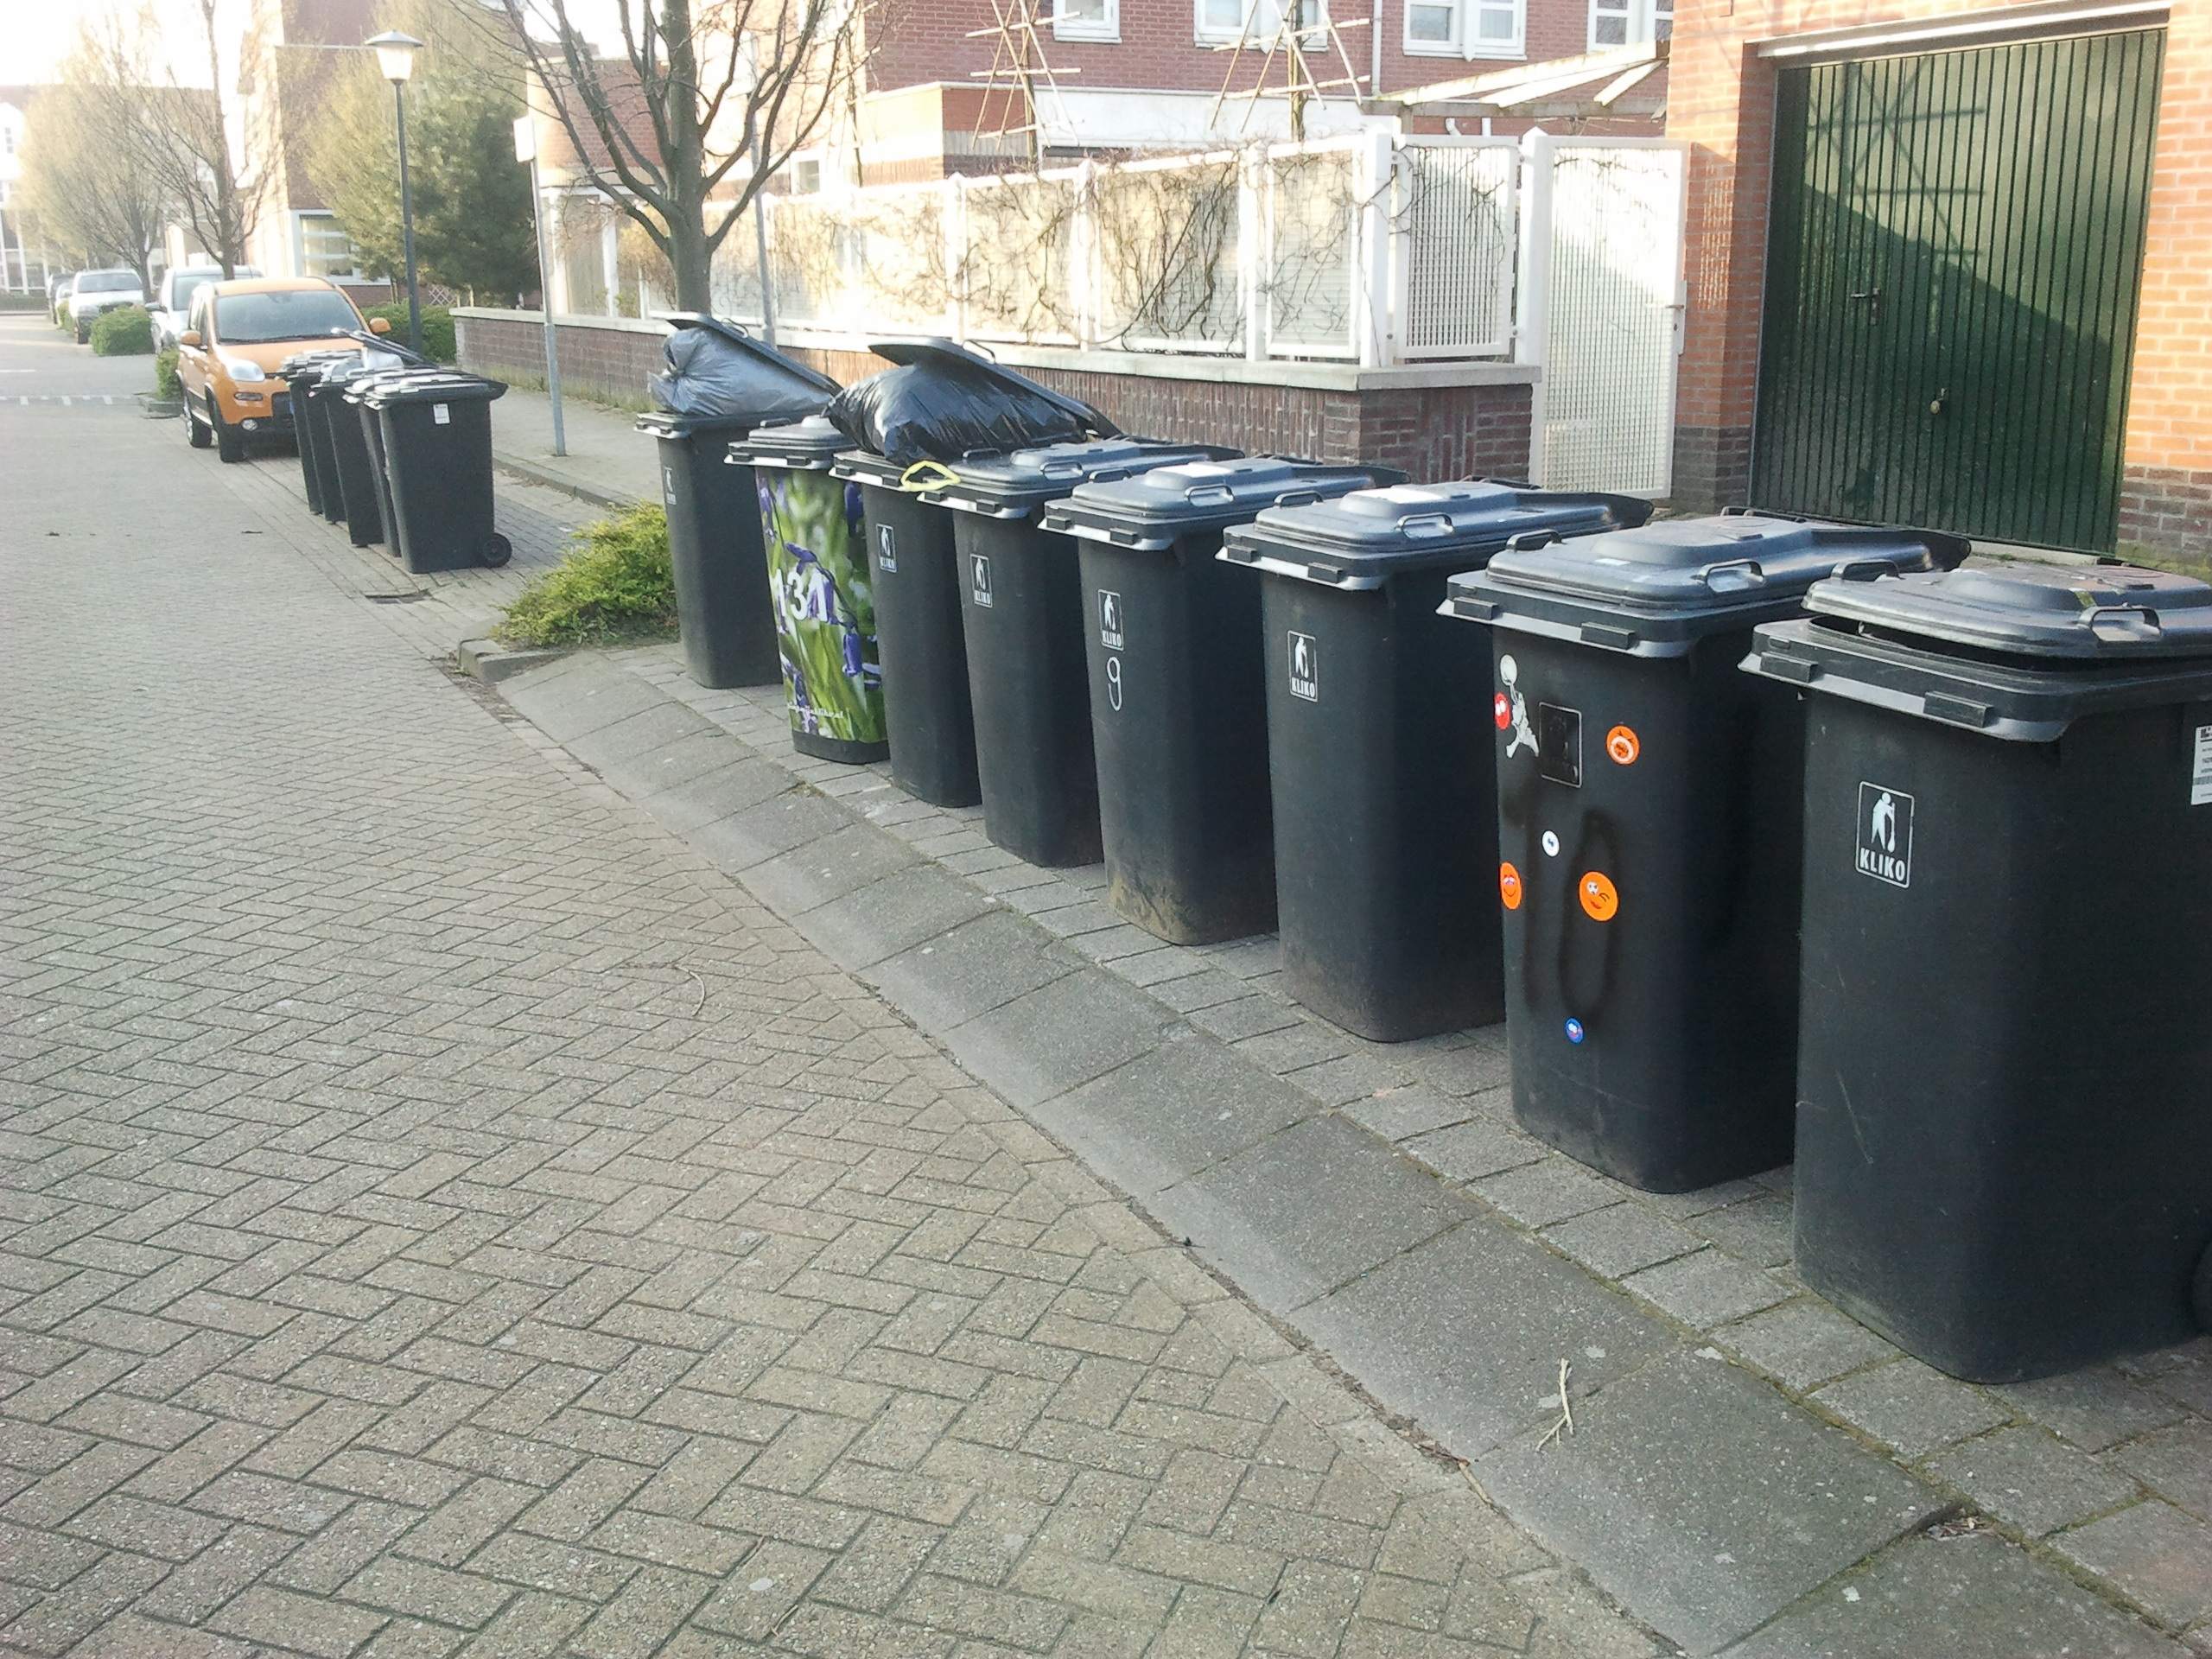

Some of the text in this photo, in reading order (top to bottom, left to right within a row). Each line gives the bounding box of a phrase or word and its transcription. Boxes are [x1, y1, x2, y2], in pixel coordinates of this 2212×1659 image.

[772, 568, 828, 622] 131
[1102, 630, 1122, 647] KLIKO
[1107, 657, 1122, 711] 9
[1291, 677, 1315, 698] KLIKO
[1859, 847, 1905, 881] KLIKO
